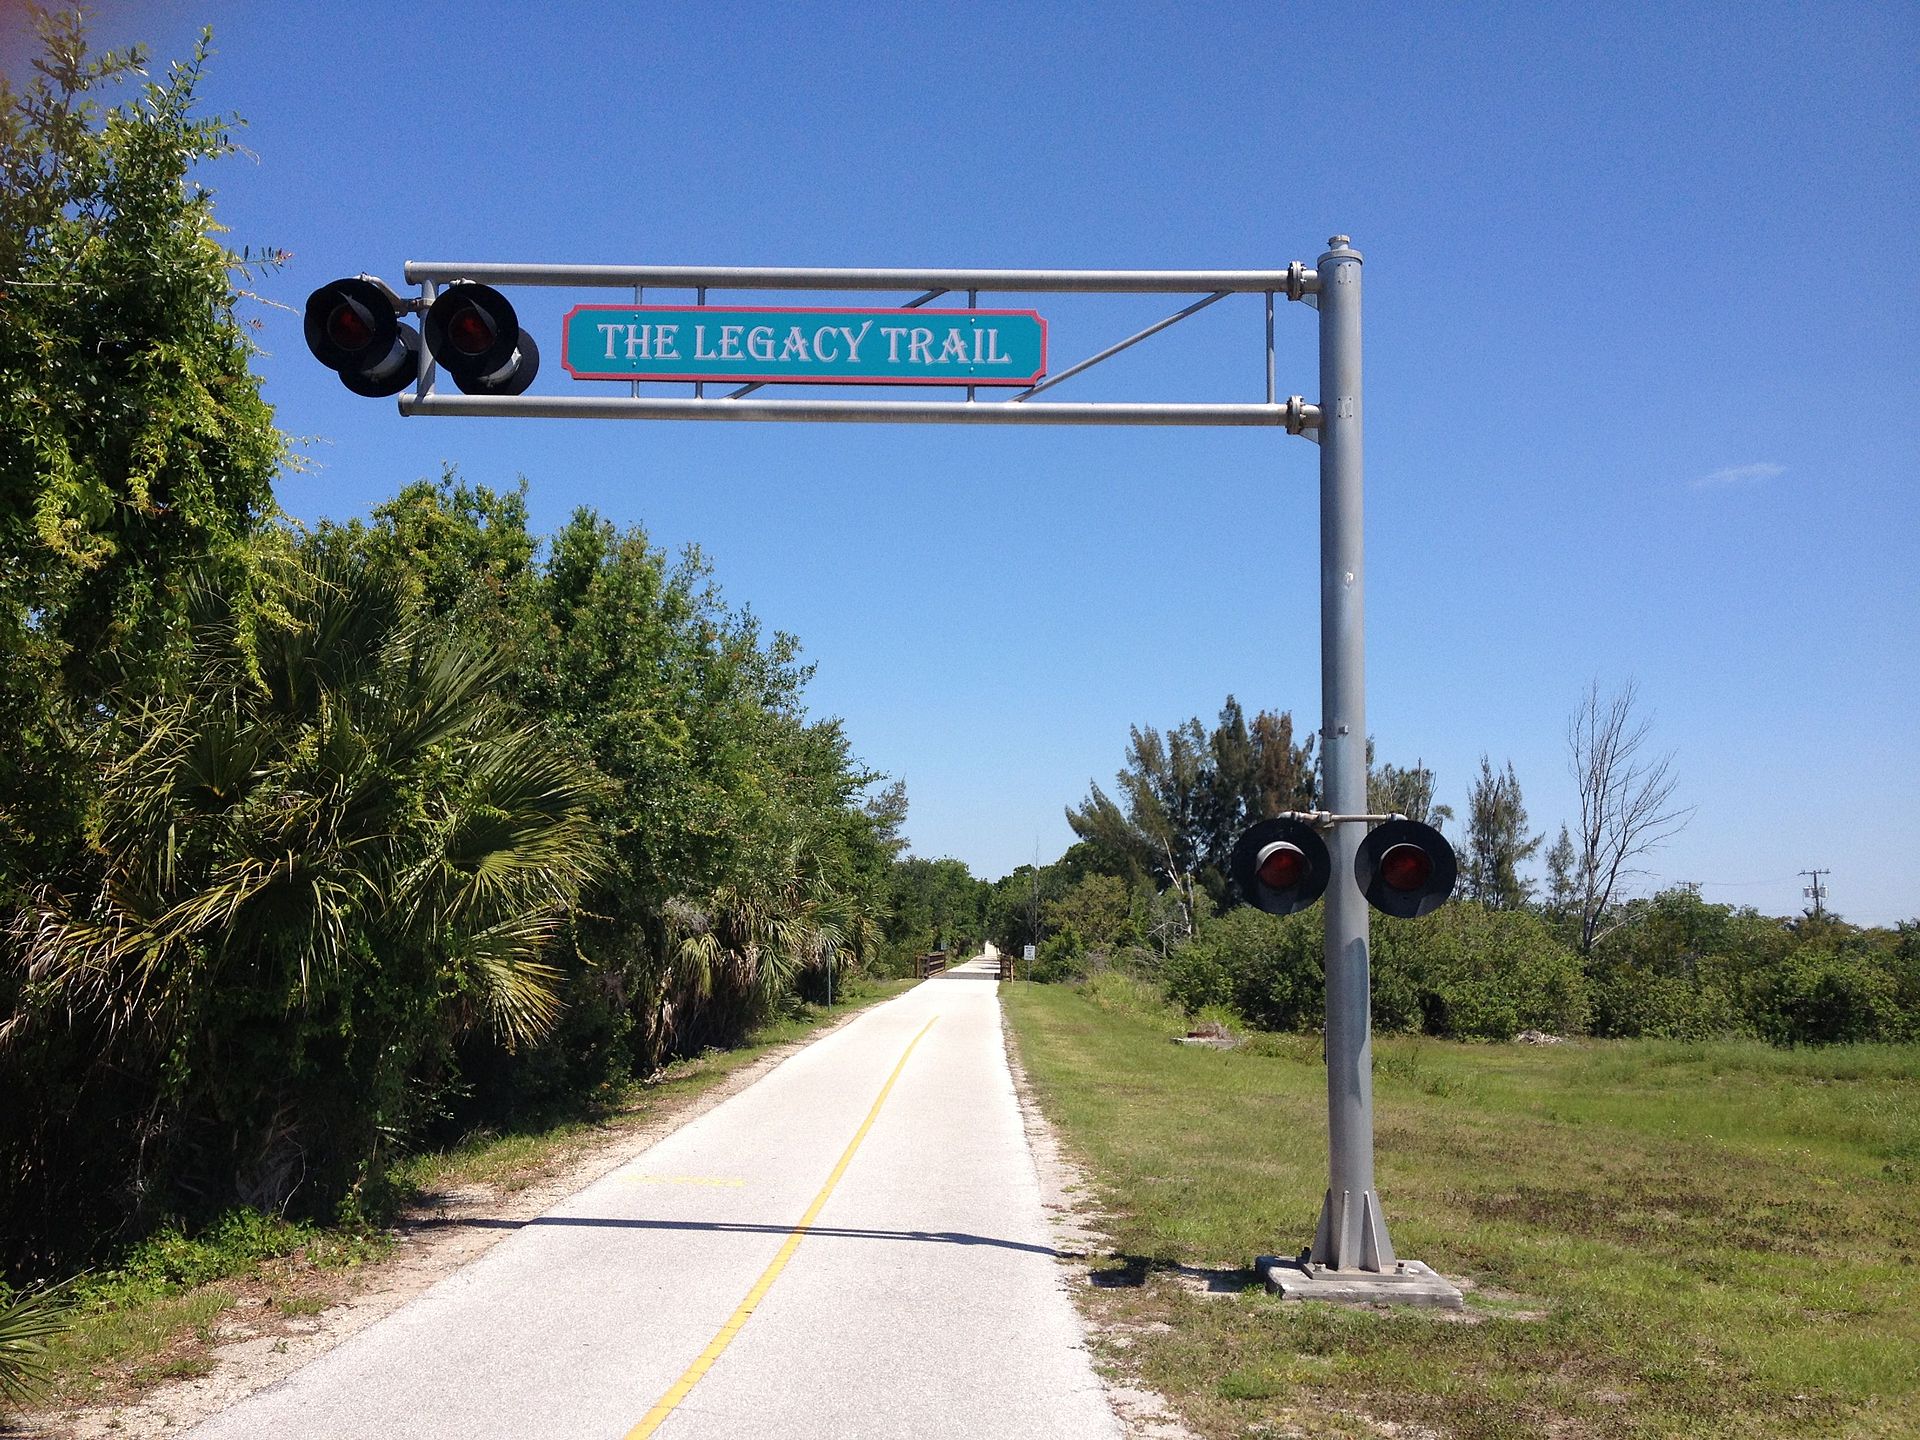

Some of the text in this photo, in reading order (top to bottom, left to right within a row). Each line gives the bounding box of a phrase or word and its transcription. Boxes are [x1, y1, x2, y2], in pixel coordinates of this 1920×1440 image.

[597, 320, 1012, 366] THE LEGACY TRAIL
